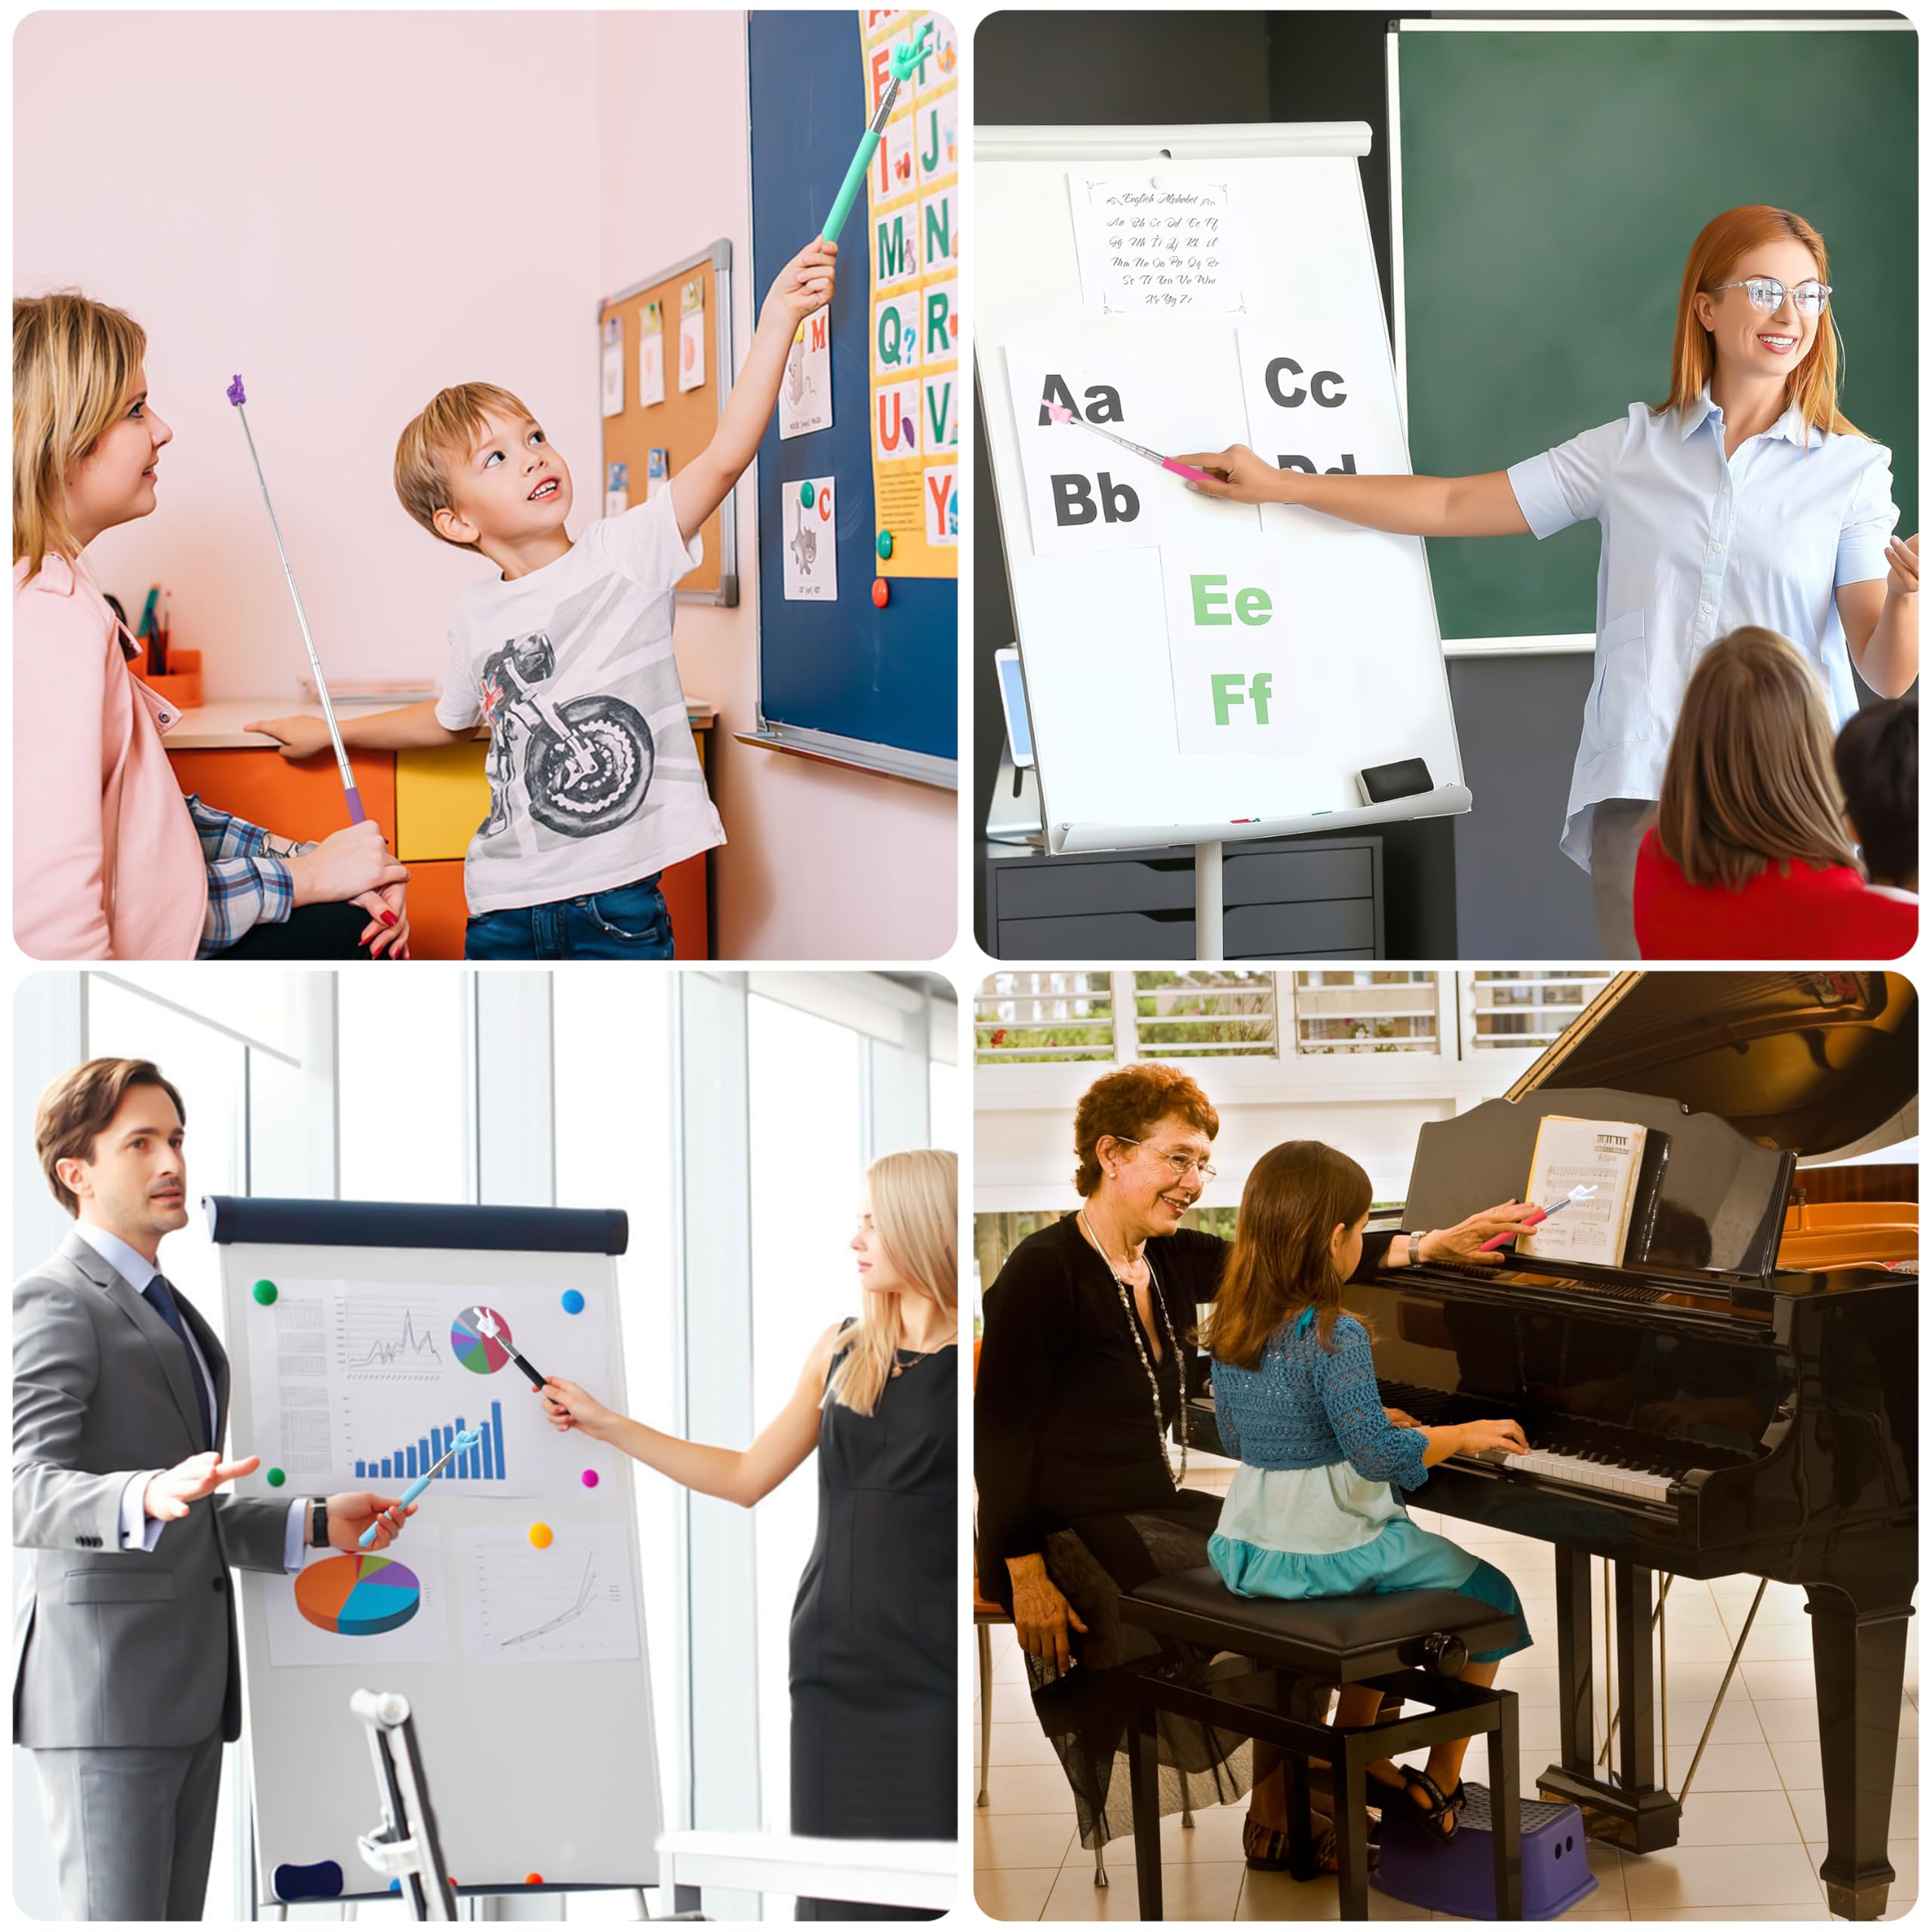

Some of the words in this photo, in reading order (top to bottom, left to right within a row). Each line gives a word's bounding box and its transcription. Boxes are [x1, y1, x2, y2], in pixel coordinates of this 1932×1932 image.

[872, 48, 891, 112] E
[881, 136, 889, 193] I
[921, 109, 939, 172] J
[1122, 192, 1154, 208] English
[1157, 192, 1198, 205] Alphabet
[878, 216, 904, 280] M
[925, 198, 949, 263] N
[811, 315, 826, 353] M
[878, 306, 902, 366] Q
[928, 292, 950, 354] R
[1038, 374, 1124, 426] Aa
[1265, 357, 1348, 408] Cc
[879, 392, 900, 451] U
[926, 382, 951, 444] V
[818, 488, 831, 522] C
[928, 474, 952, 536] Y
[1050, 471, 1141, 527] Bb
[1189, 574, 1273, 626] Ee
[1211, 672, 1272, 725] Ff
